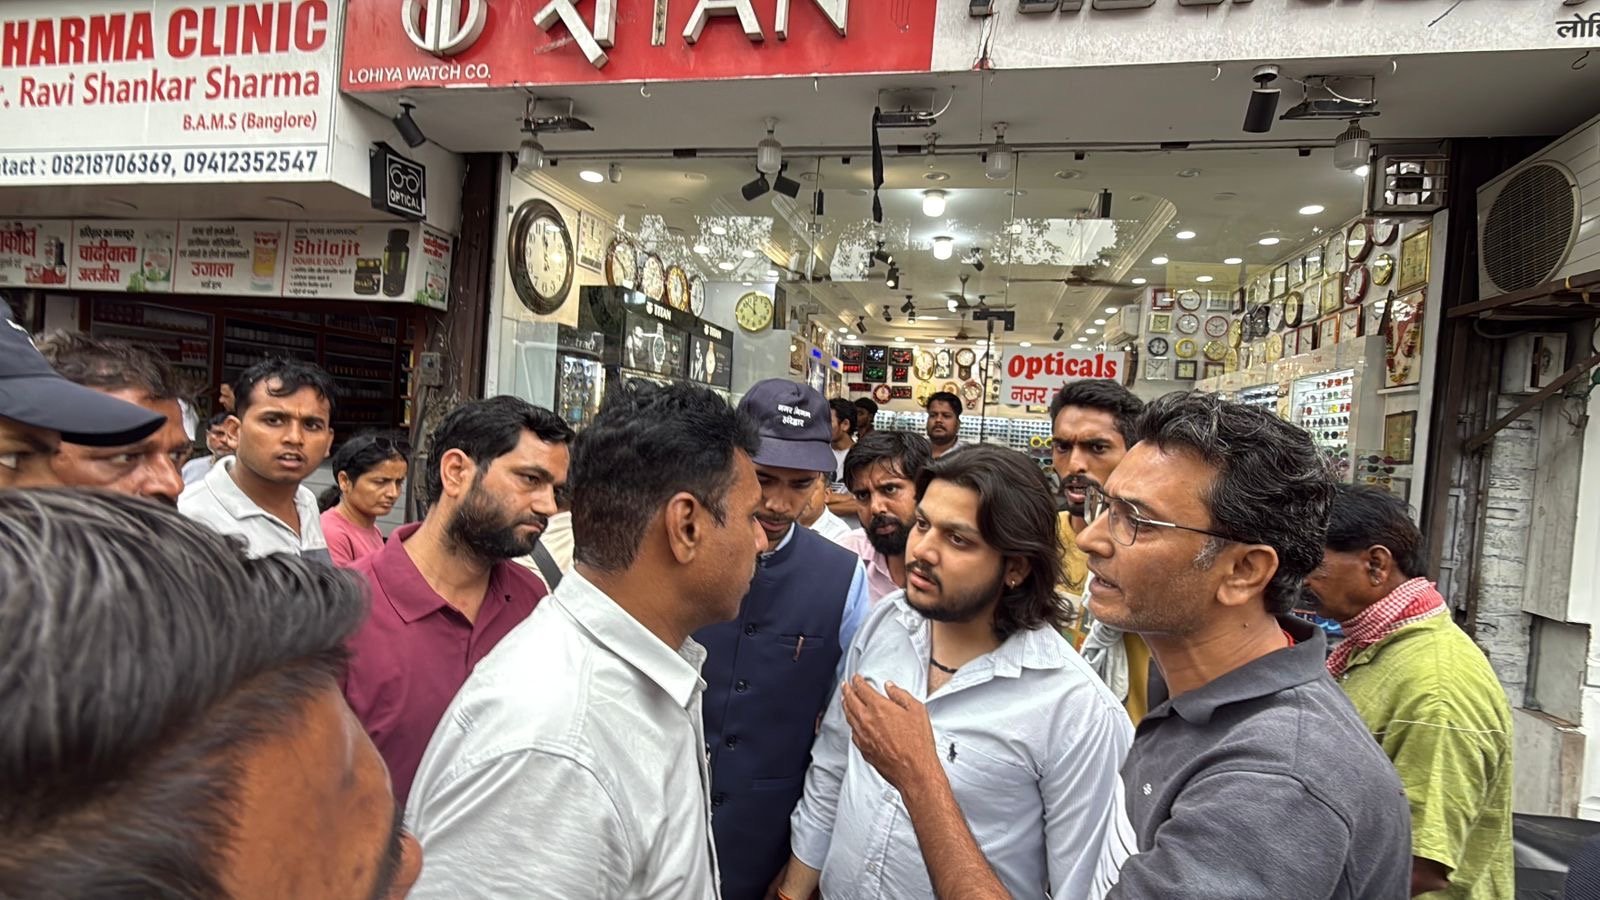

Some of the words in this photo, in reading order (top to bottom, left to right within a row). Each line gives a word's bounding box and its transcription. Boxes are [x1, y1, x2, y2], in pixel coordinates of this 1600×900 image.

[2, 12, 155, 68] HARMA
[167, 0, 329, 58] CLINIC
[349, 67, 402, 84] LOHIYA
[406, 63, 461, 80] WATCH
[465, 63, 491, 80] CO.
[20, 72, 75, 107] Ravi
[82, 69, 197, 106] Shankar
[204, 64, 320, 100] Sharma
[183, 112, 237, 131] B.A.M.S
[241, 110, 317, 134] (Banglore)
[0, 155, 36, 176] tact
[52, 152, 176, 177] 08218706369,
[184, 150, 318, 174] 09412352547
[390, 189, 421, 211] OPTICAL
[79, 239, 137, 263] चांदीवाला
[293, 239, 361, 260] Shilajit
[191, 261, 235, 278] उजाला
[292, 256, 320, 266] DOUBLE
[653, 303, 672, 321] TITAN
[1007, 351, 1118, 381] Opticals
[1010, 385, 1048, 404] नजर
